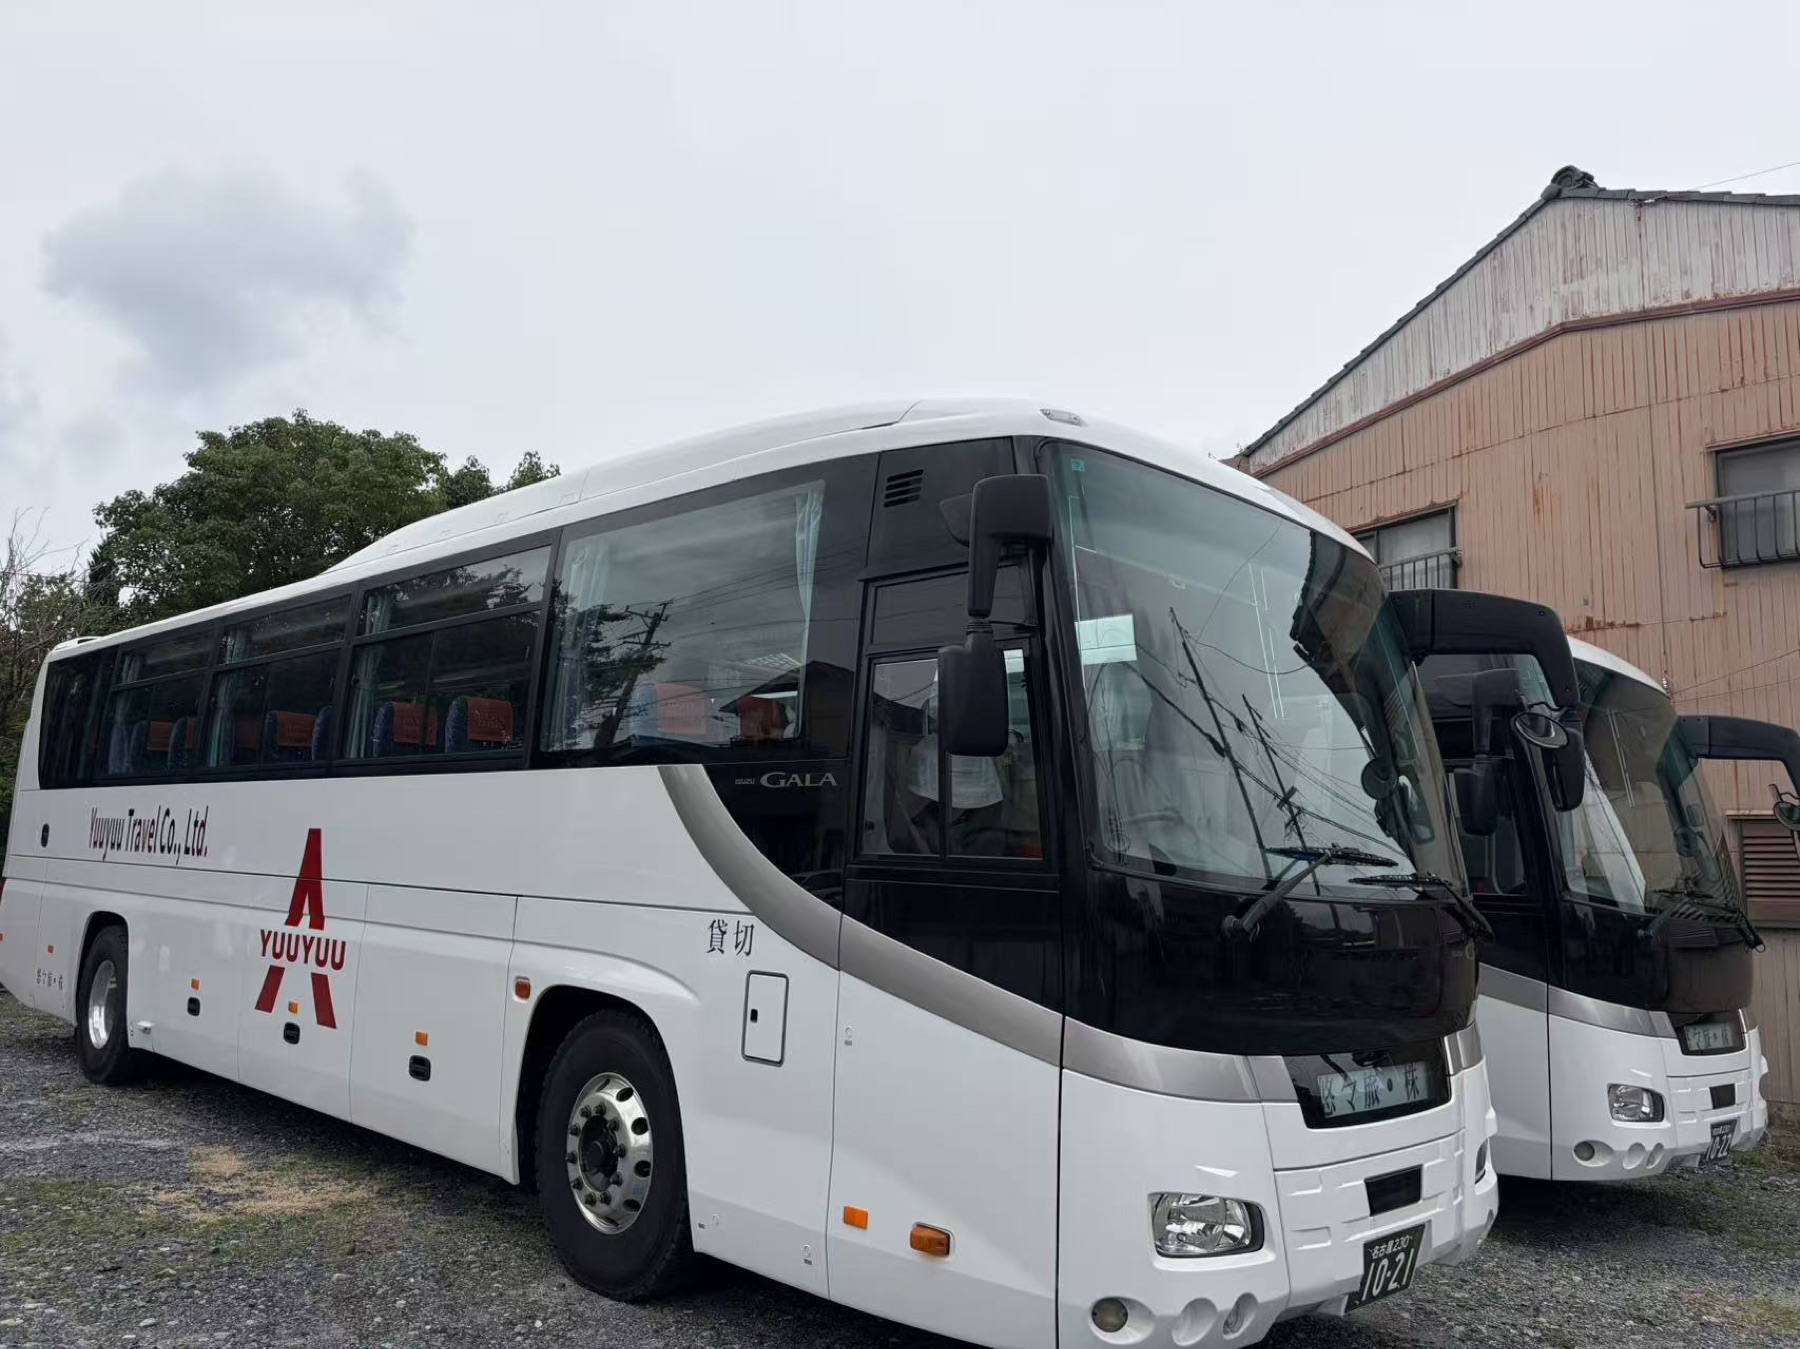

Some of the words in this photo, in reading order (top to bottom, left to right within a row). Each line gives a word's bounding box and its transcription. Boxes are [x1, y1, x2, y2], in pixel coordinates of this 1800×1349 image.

[760, 771, 839, 788] GALA
[89, 807, 125, 861] Yuuyuu
[125, 805, 161, 853] Travel
[184, 805, 209, 857] Ltd.
[260, 929, 347, 971] YUUYUU
[706, 919, 755, 956] 貸切
